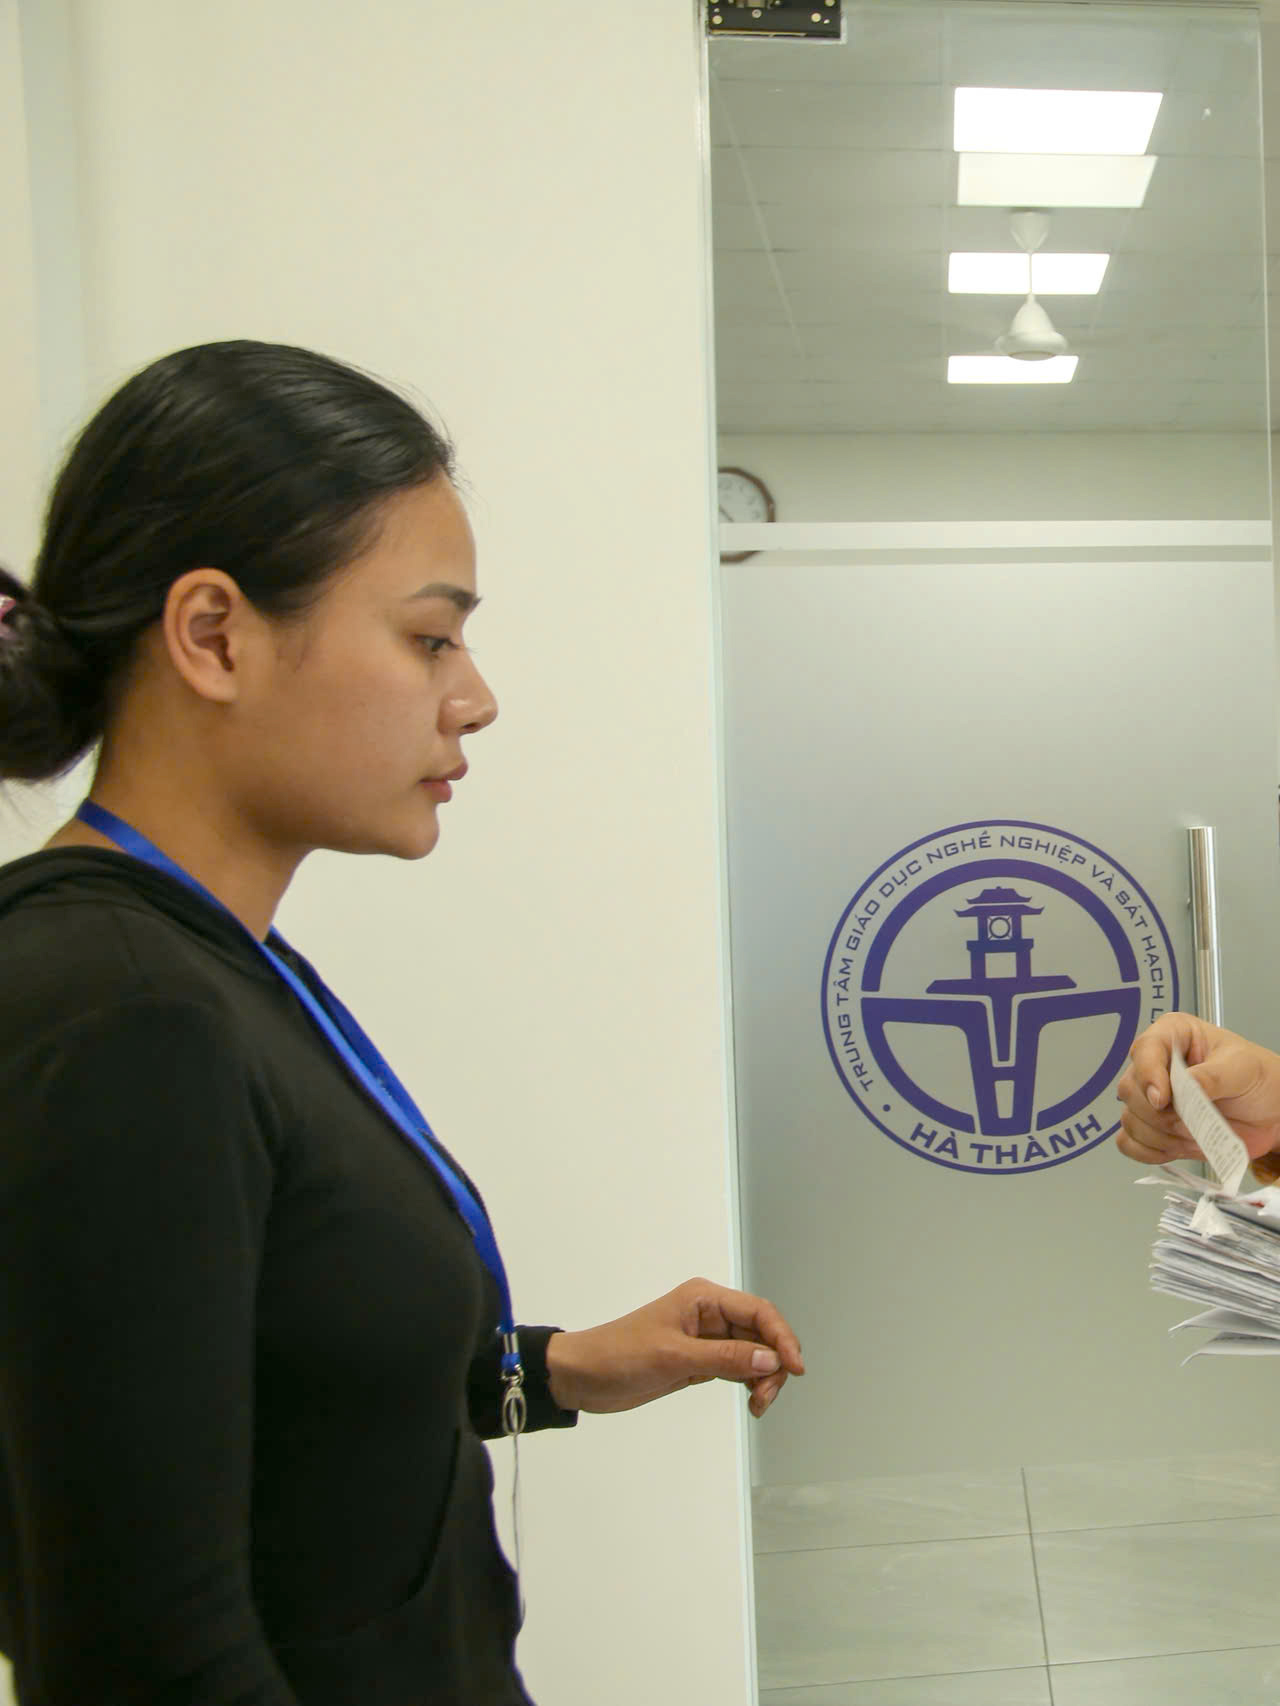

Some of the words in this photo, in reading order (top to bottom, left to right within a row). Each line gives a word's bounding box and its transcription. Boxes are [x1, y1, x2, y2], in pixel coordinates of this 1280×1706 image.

[1000, 834, 1087, 866] NGHIỆP
[879, 859, 923, 899] DỤC
[1091, 864, 1115, 892] VÀ
[846, 899, 881, 951] GIÁO
[1115, 890, 1148, 929] SÁT
[833, 957, 854, 1007] TÂM
[1141, 935, 1165, 1000] HẠCH
[837, 1013, 874, 1092] TRUNG
[909, 1122, 959, 1160] HÀ
[969, 1113, 1102, 1165] THÀNH
